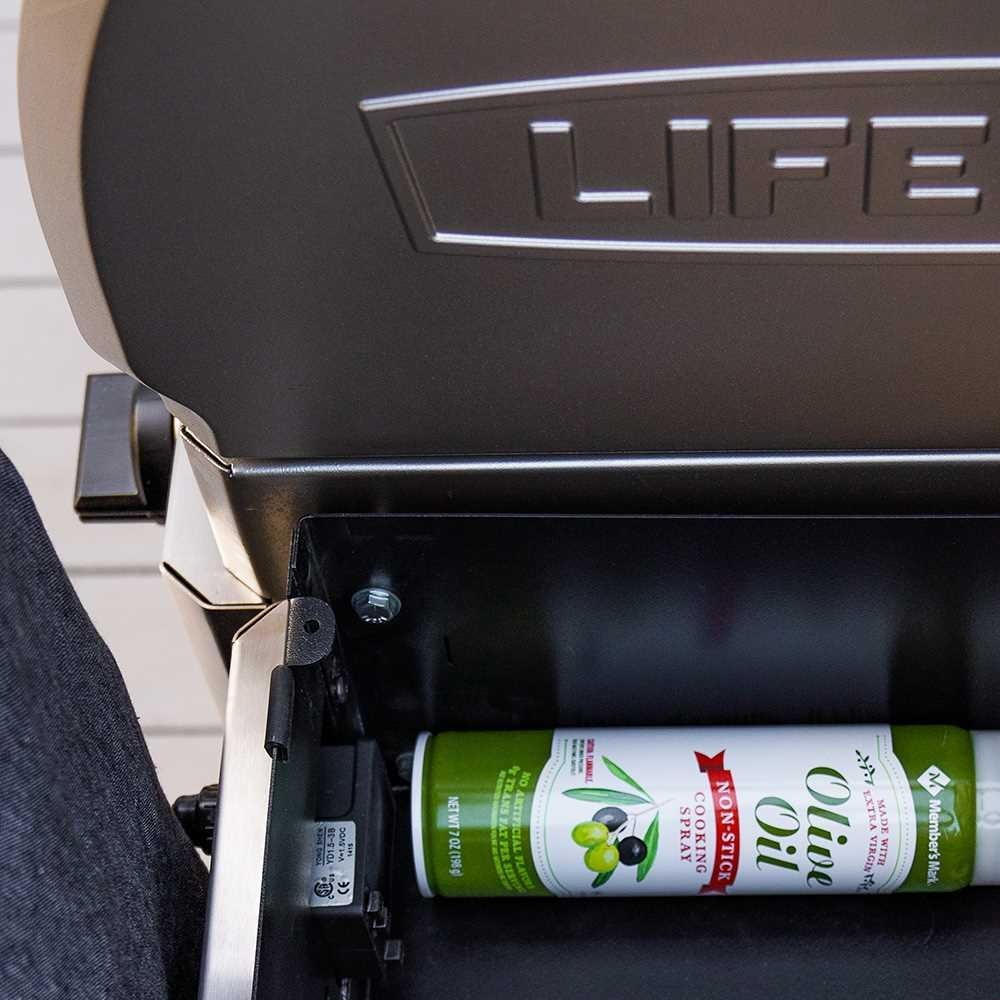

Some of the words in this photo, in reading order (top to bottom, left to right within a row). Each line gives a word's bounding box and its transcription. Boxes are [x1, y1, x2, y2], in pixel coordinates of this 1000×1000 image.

[499, 778, 517, 816] TRANS
[519, 771, 532, 788] NO
[447, 796, 460, 815] NET
[447, 816, 460, 830] WT
[512, 789, 526, 853] ARTIFICIAL
[863, 789, 876, 831] EXTRA
[877, 799, 889, 835] MADE
[448, 839, 461, 849] OZ
[498, 817, 510, 838] FAT
[679, 806, 692, 864] SPRAY
[694, 792, 708, 875] COOKING
[716, 780, 736, 882] NON-STICK
[754, 796, 801, 872] Oil
[804, 766, 852, 890] Olive
[927, 800, 942, 860] Member's
[447, 851, 463, 869] (198
[499, 841, 512, 861] PER
[863, 835, 877, 874] VIRGIN
[877, 838, 889, 867] WITH
